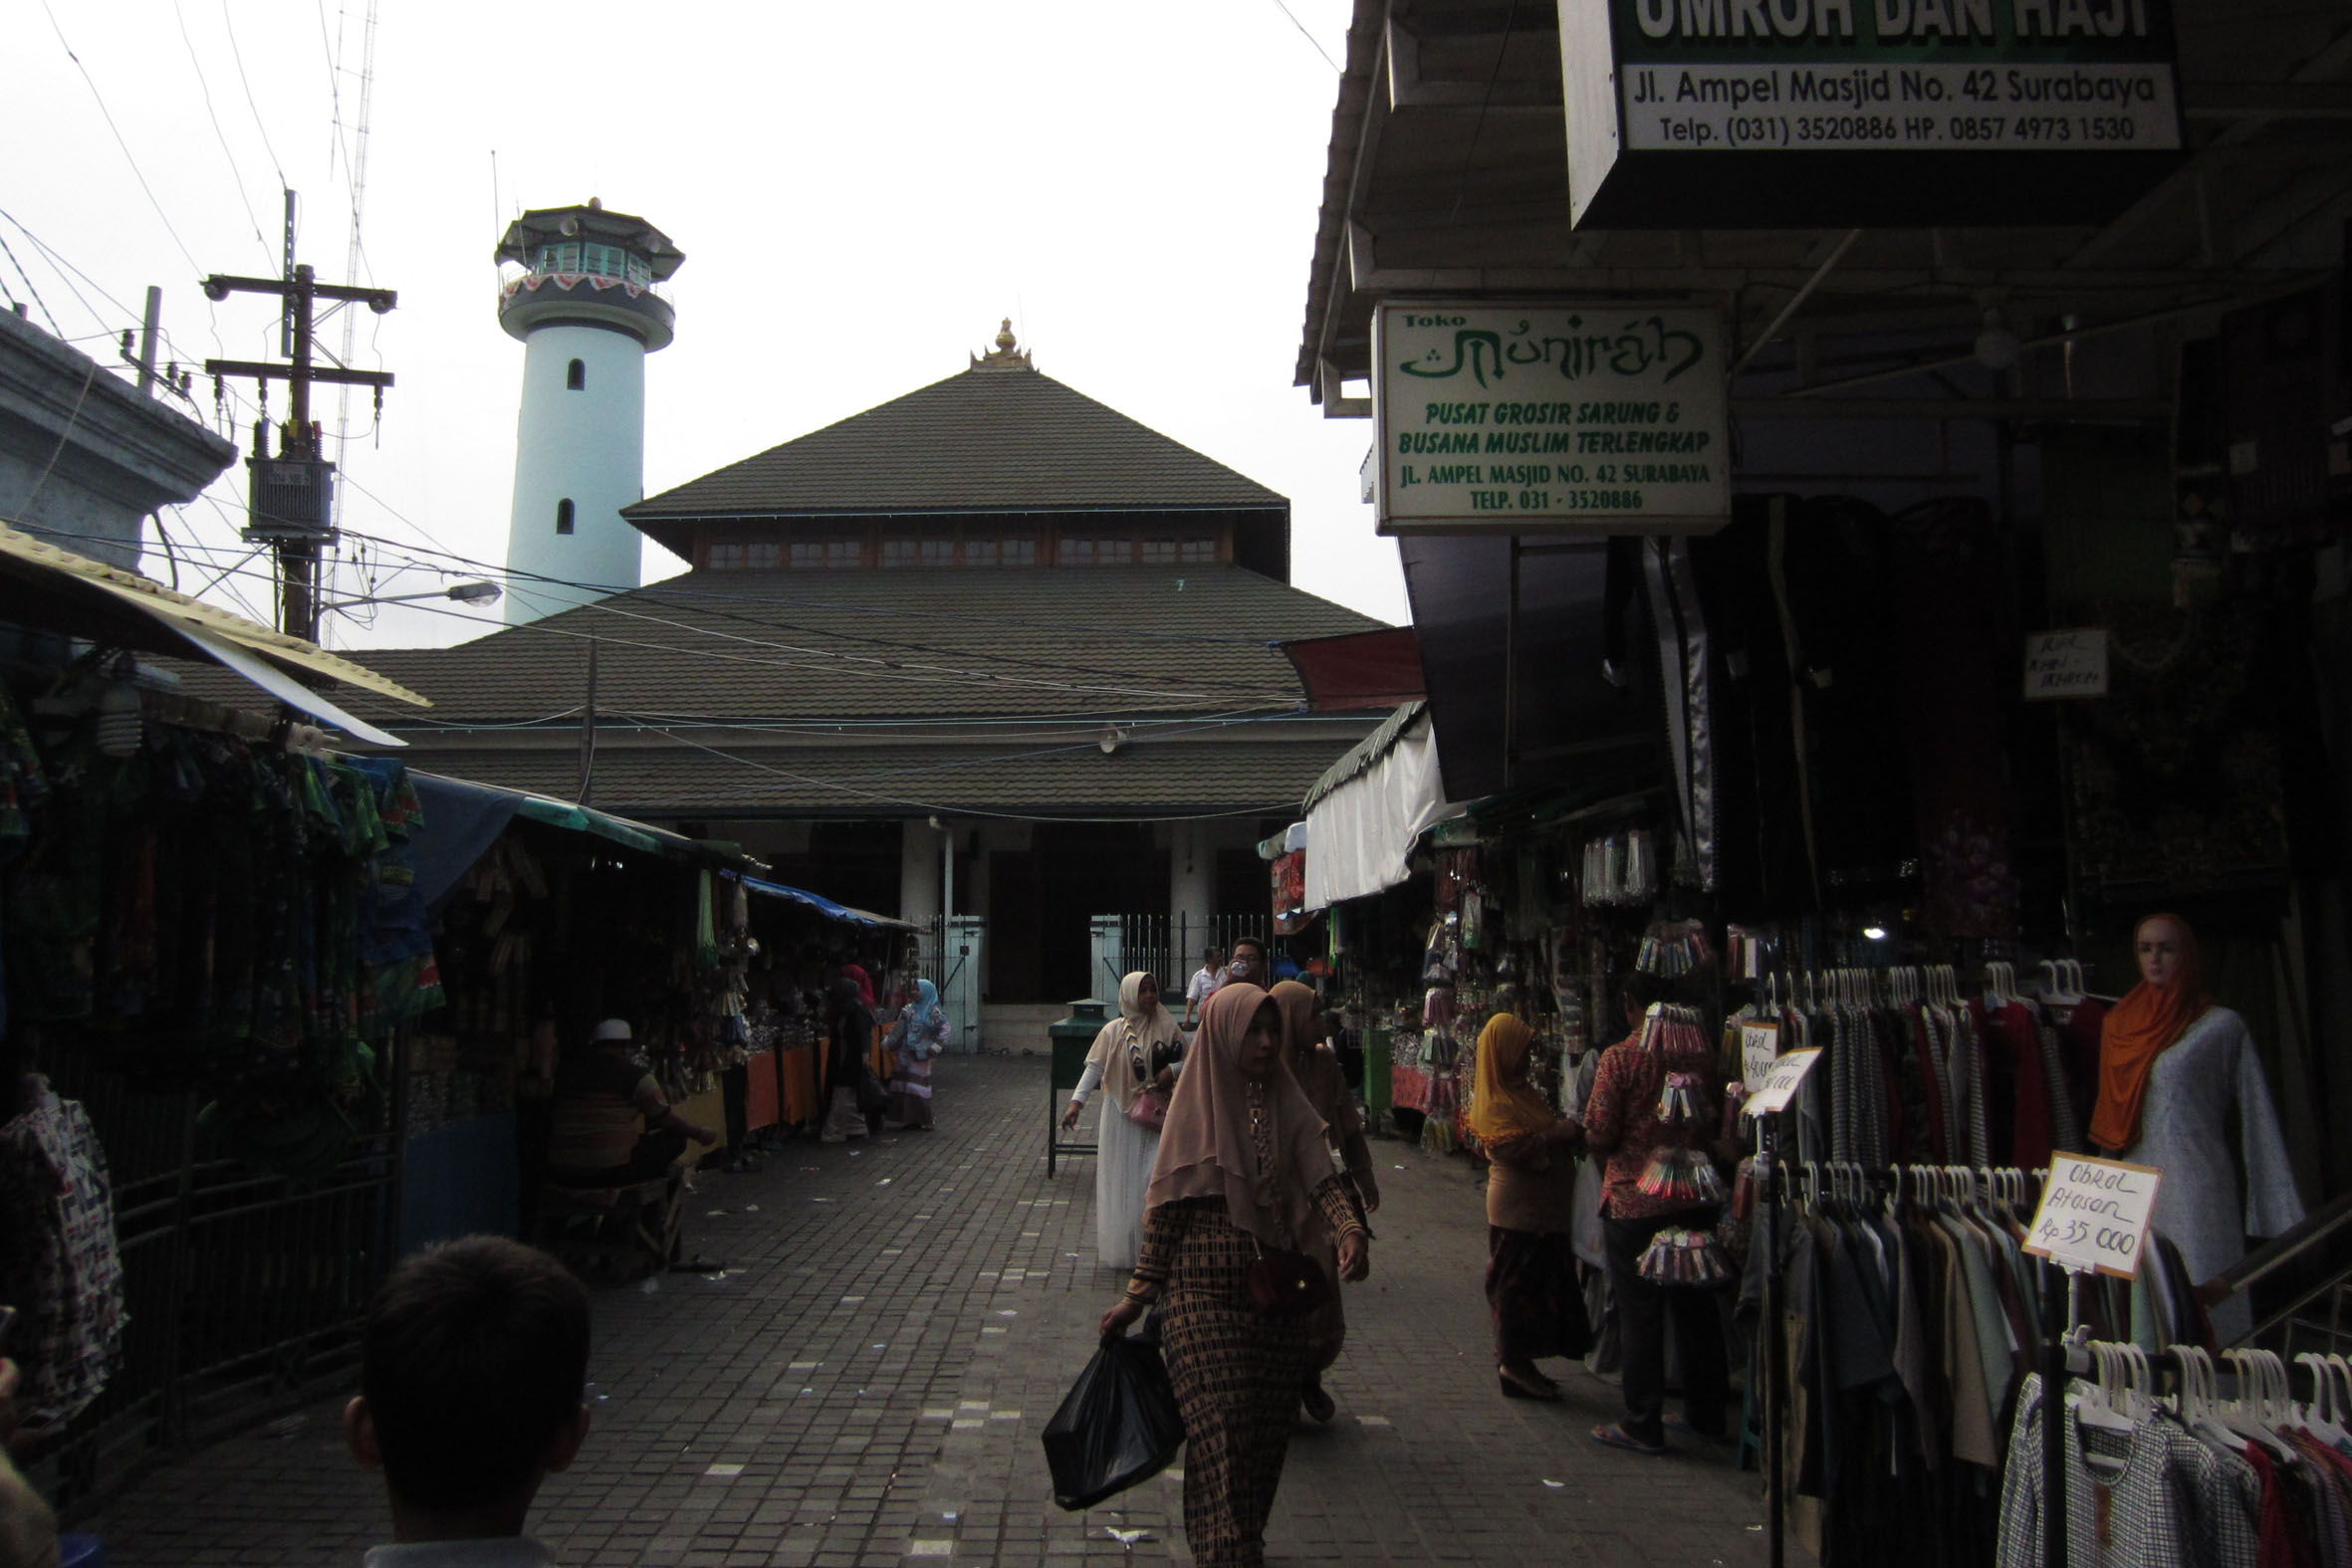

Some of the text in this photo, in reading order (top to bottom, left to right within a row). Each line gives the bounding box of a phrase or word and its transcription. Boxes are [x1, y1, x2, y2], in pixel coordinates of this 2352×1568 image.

[1635, 0, 2148, 38] UMROH DAN HAJI
[1634, 70, 2156, 110] Jl. Ampel Masjid No. 42 Surabaya
[1660, 116, 2134, 146] Telp. (031) 3520886 HP. 0857 4973 1530
[1402, 314, 1467, 328] Toko
[1425, 401, 1680, 425] PUSAT GROSIR SARUNG &
[1399, 431, 1710, 454] BUSANA MUSLIM TERLENGKAP
[1400, 465, 1710, 489] JL. AMPEL MASJID NO. 42 SURABAYA
[1470, 491, 1513, 510] TELP.
[1520, 492, 1549, 509] 031
[1568, 491, 1643, 509] 3520886
[2038, 1219, 2059, 1242] Rp
